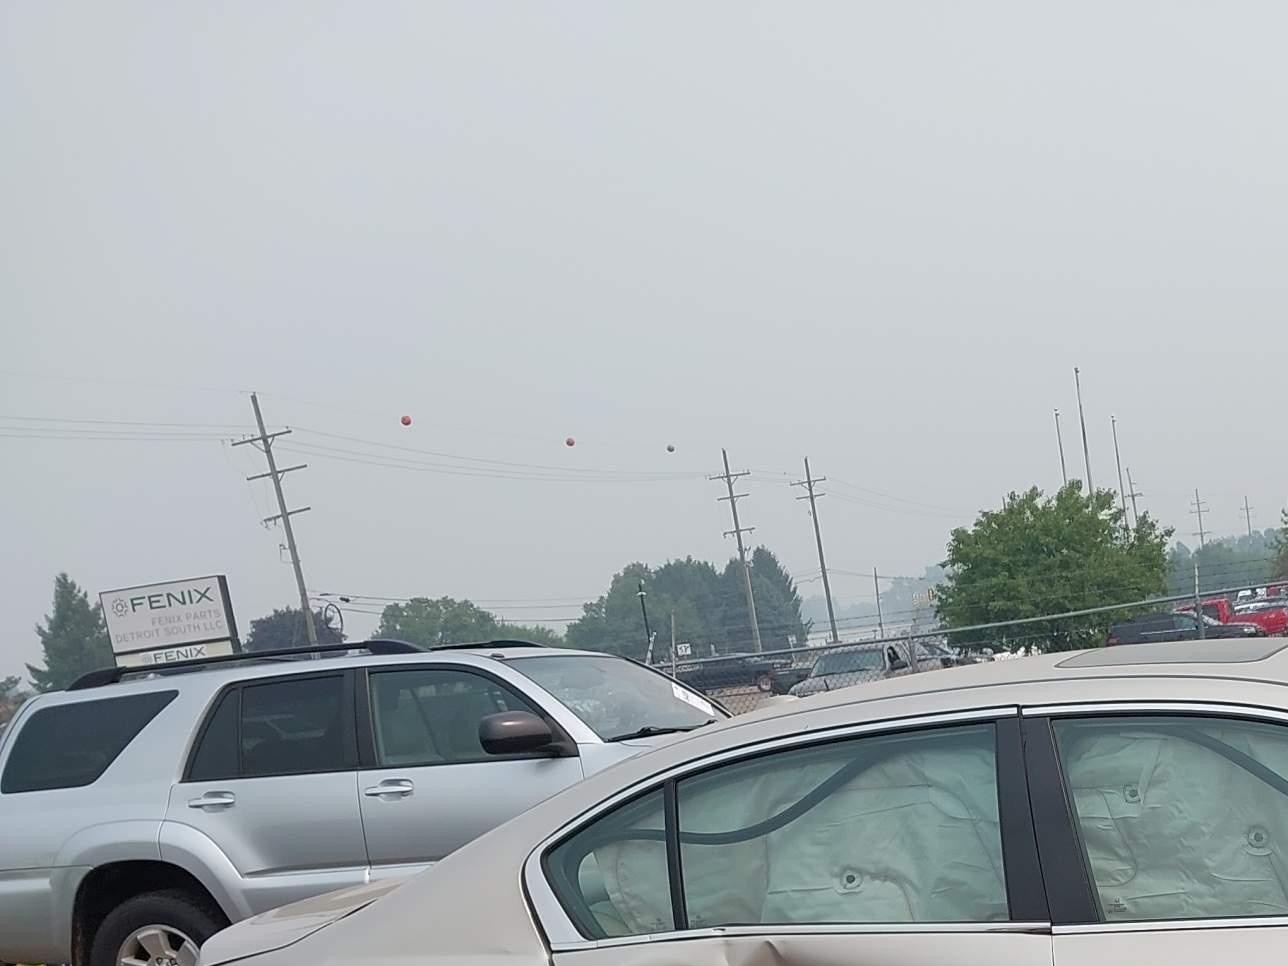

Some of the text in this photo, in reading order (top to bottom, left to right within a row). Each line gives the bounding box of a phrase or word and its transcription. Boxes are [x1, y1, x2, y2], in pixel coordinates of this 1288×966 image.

[130, 587, 214, 612] FENIX
[152, 609, 222, 627] FENIX PARTS
[116, 620, 224, 643] DETROIT SOUTH LLC
[153, 647, 206, 663] FENIX
